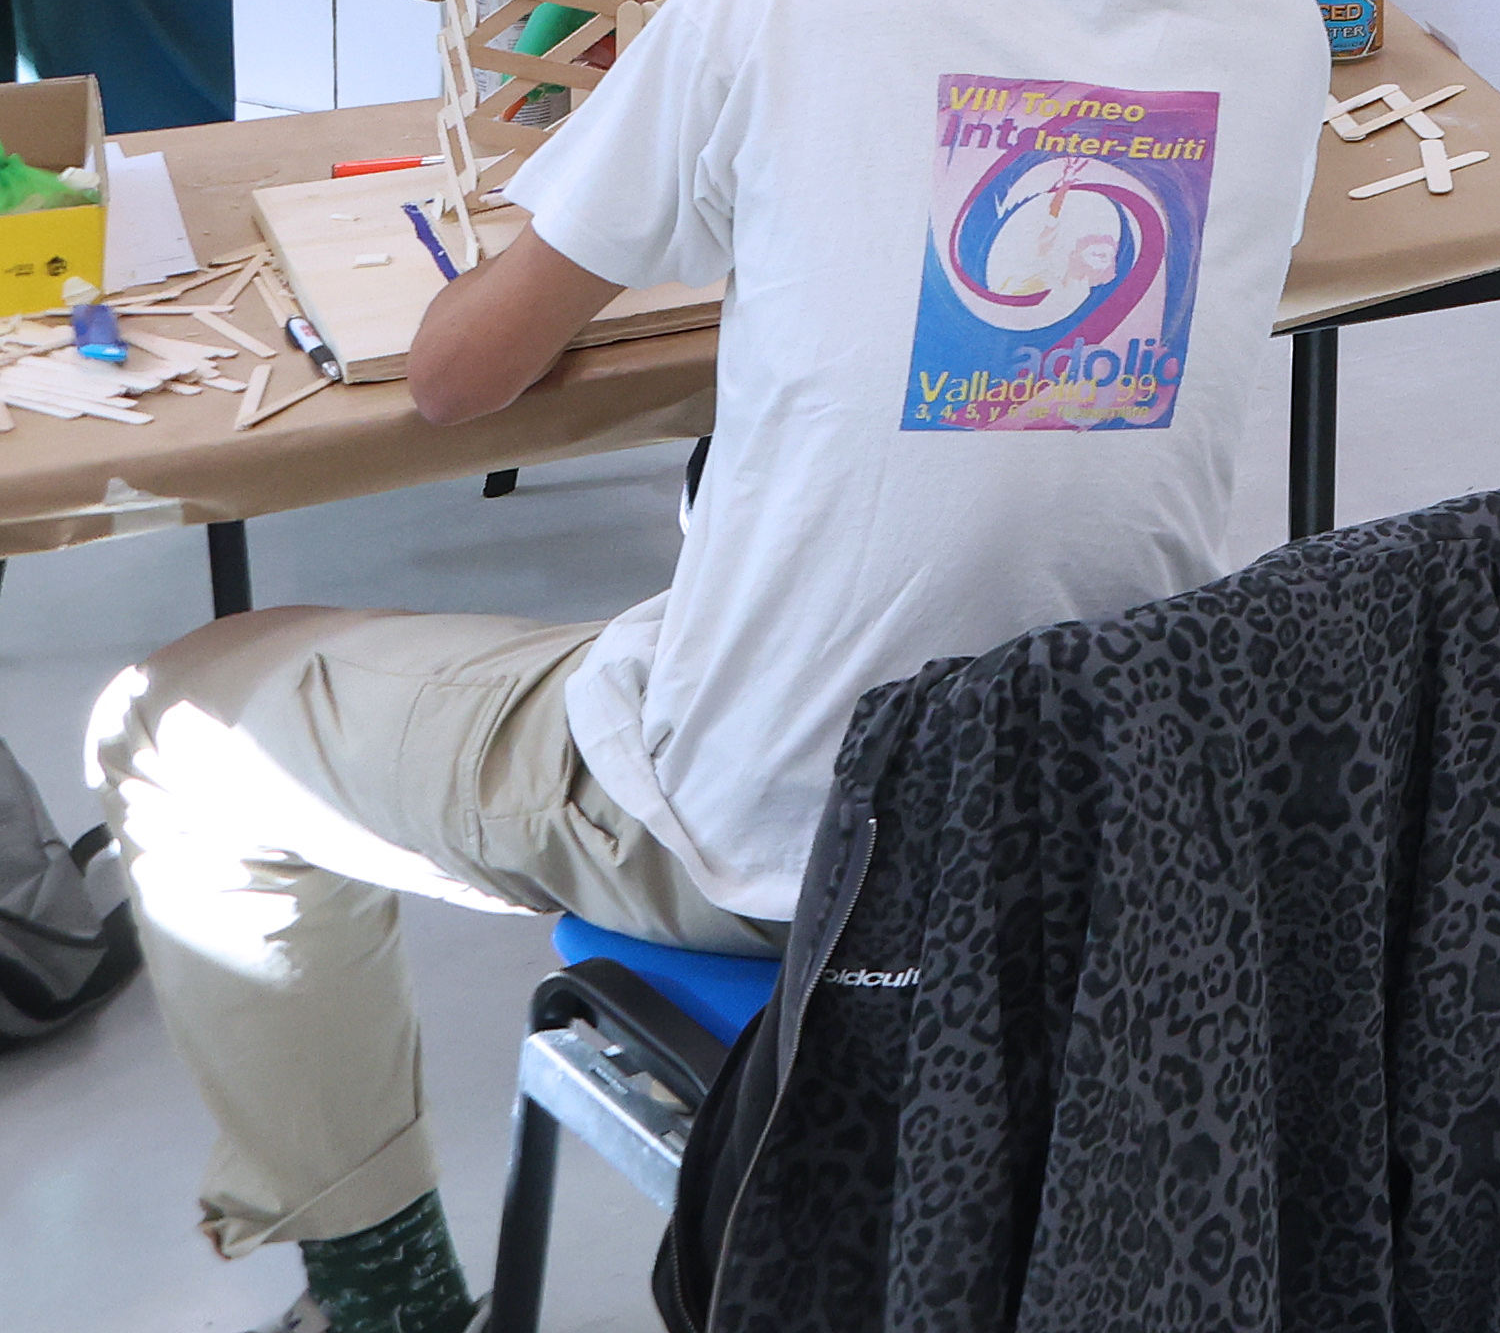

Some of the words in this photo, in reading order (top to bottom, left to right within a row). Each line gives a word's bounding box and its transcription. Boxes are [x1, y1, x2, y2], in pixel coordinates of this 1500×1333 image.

[949, 85, 1010, 113] VIII
[1020, 90, 1146, 124] Torneo
[1034, 128, 1207, 162] Inter-Euiti
[918, 370, 1097, 405] Valladolid
[915, 404, 932, 422] 3,
[939, 404, 957, 422] 4,
[964, 404, 981, 422] 5,
